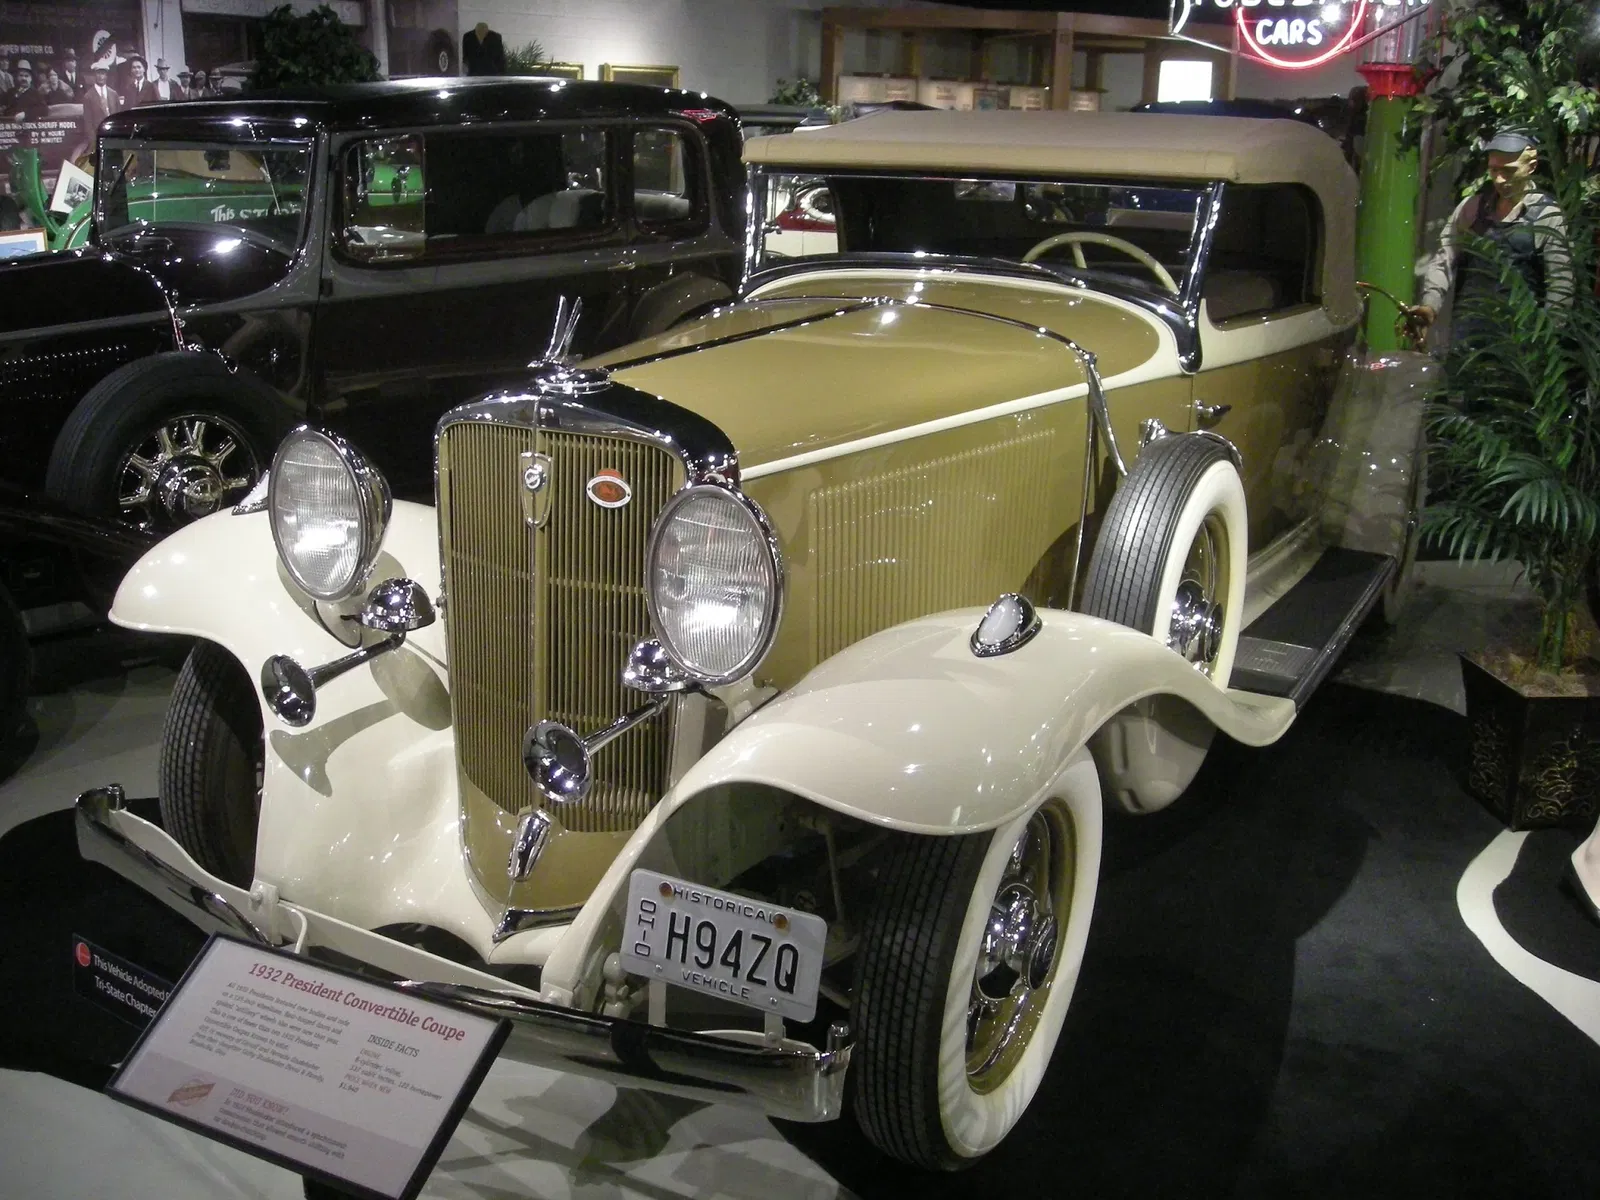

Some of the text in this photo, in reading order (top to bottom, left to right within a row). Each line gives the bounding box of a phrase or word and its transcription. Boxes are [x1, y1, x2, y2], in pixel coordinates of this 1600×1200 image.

[1255, 19, 1323, 46] CARS
[211, 204, 235, 222] This
[674, 885, 774, 925] HISTORICAL
[634, 899, 657, 957] OHIO
[665, 911, 799, 994] H94ZQ
[93, 954, 107, 971] This
[107, 963, 133, 984] Vehicle
[133, 976, 165, 1001] Adopted
[94, 975, 156, 1017] Tri-State Chapter
[682, 970, 750, 999] VEHICLE
[248, 963, 466, 1041] 1932 President Convertible Coupe
[368, 1034, 420, 1058] INSIDE FACTS
